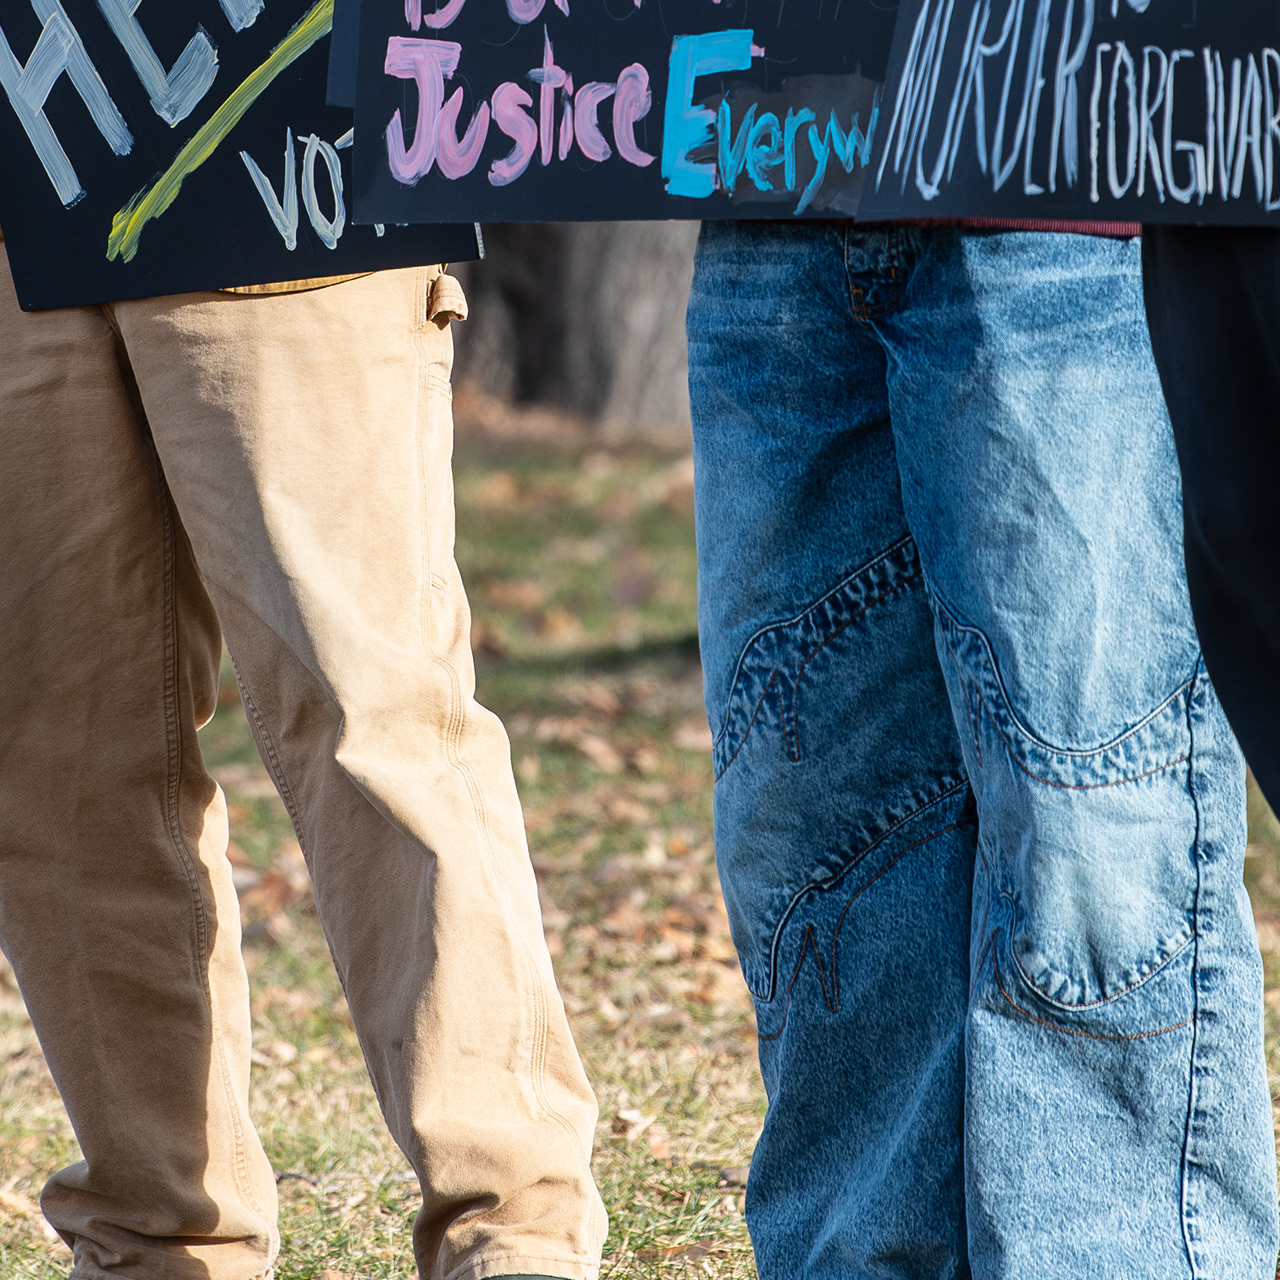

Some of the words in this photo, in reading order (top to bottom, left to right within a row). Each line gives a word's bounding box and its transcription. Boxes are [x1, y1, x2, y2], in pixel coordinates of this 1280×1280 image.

[238, 125, 410, 251] VO
[383, 23, 656, 187] Justice
[661, 28, 882, 217] Everyw
